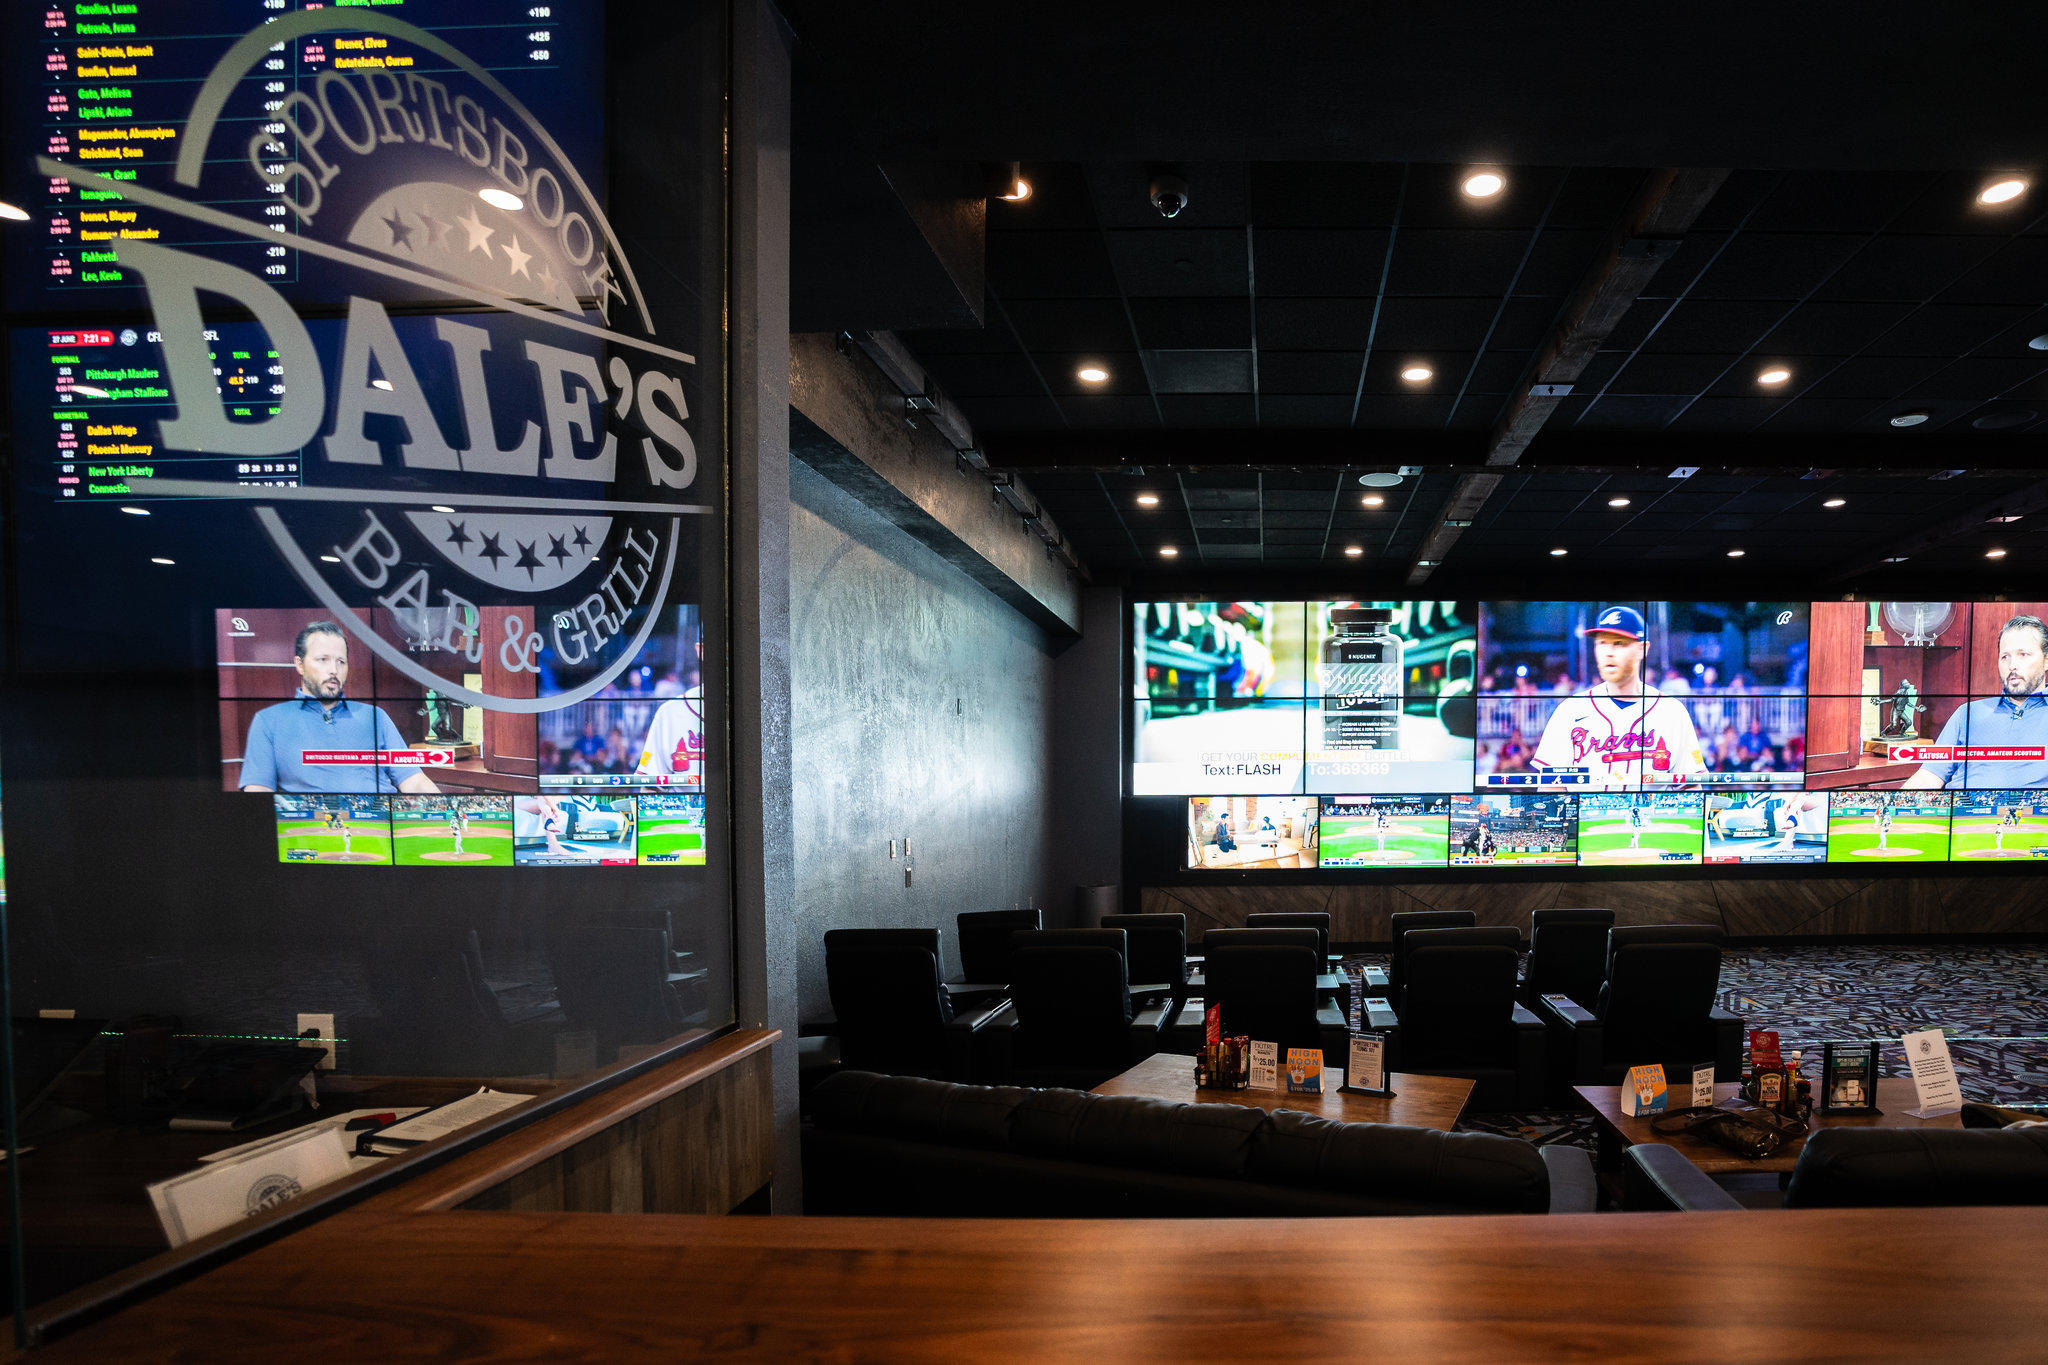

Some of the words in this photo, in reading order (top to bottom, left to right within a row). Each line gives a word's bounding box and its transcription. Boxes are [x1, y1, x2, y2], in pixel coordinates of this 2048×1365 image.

[77, 88, 100, 100] Gato,
[100, 87, 132, 99] Melissa
[106, 106, 133, 117] Ariane
[79, 147, 122, 159] Strickland,
[122, 147, 144, 158] Sean
[114, 169, 137, 180] Grant
[248, 66, 628, 327] SPORTSBOOK
[120, 228, 160, 239] Alexander
[82, 271, 99, 283] Lee,
[99, 270, 122, 282] Kevin
[83, 333, 99, 344] 7:21
[51, 355, 80, 364] FOOTBALL
[111, 233, 698, 491] DALE'S
[86, 369, 127, 381] Pittsburgh
[127, 368, 159, 379] Maulers
[134, 387, 169, 398] Stallions
[53, 411, 89, 420] BASKETBALL
[86, 425, 112, 436] Dallas
[112, 424, 138, 437] Wings
[87, 444, 120, 455] Phoenix
[120, 444, 153, 456] Mercury
[88, 466, 106, 476] New
[106, 465, 126, 476] York
[125, 465, 154, 477] Liberty
[334, 508, 484, 664] BAR
[500, 614, 544, 673] &
[553, 527, 659, 665] GRILL
[1919, 752, 1949, 760] KATUSKA
[1236, 764, 1281, 775] FLASH
[1291, 1049, 1318, 1057] HIGH
[1288, 1058, 1319, 1066] NOON
[1635, 1066, 1660, 1075] HIGH
[1636, 1075, 1664, 1084] NOON
